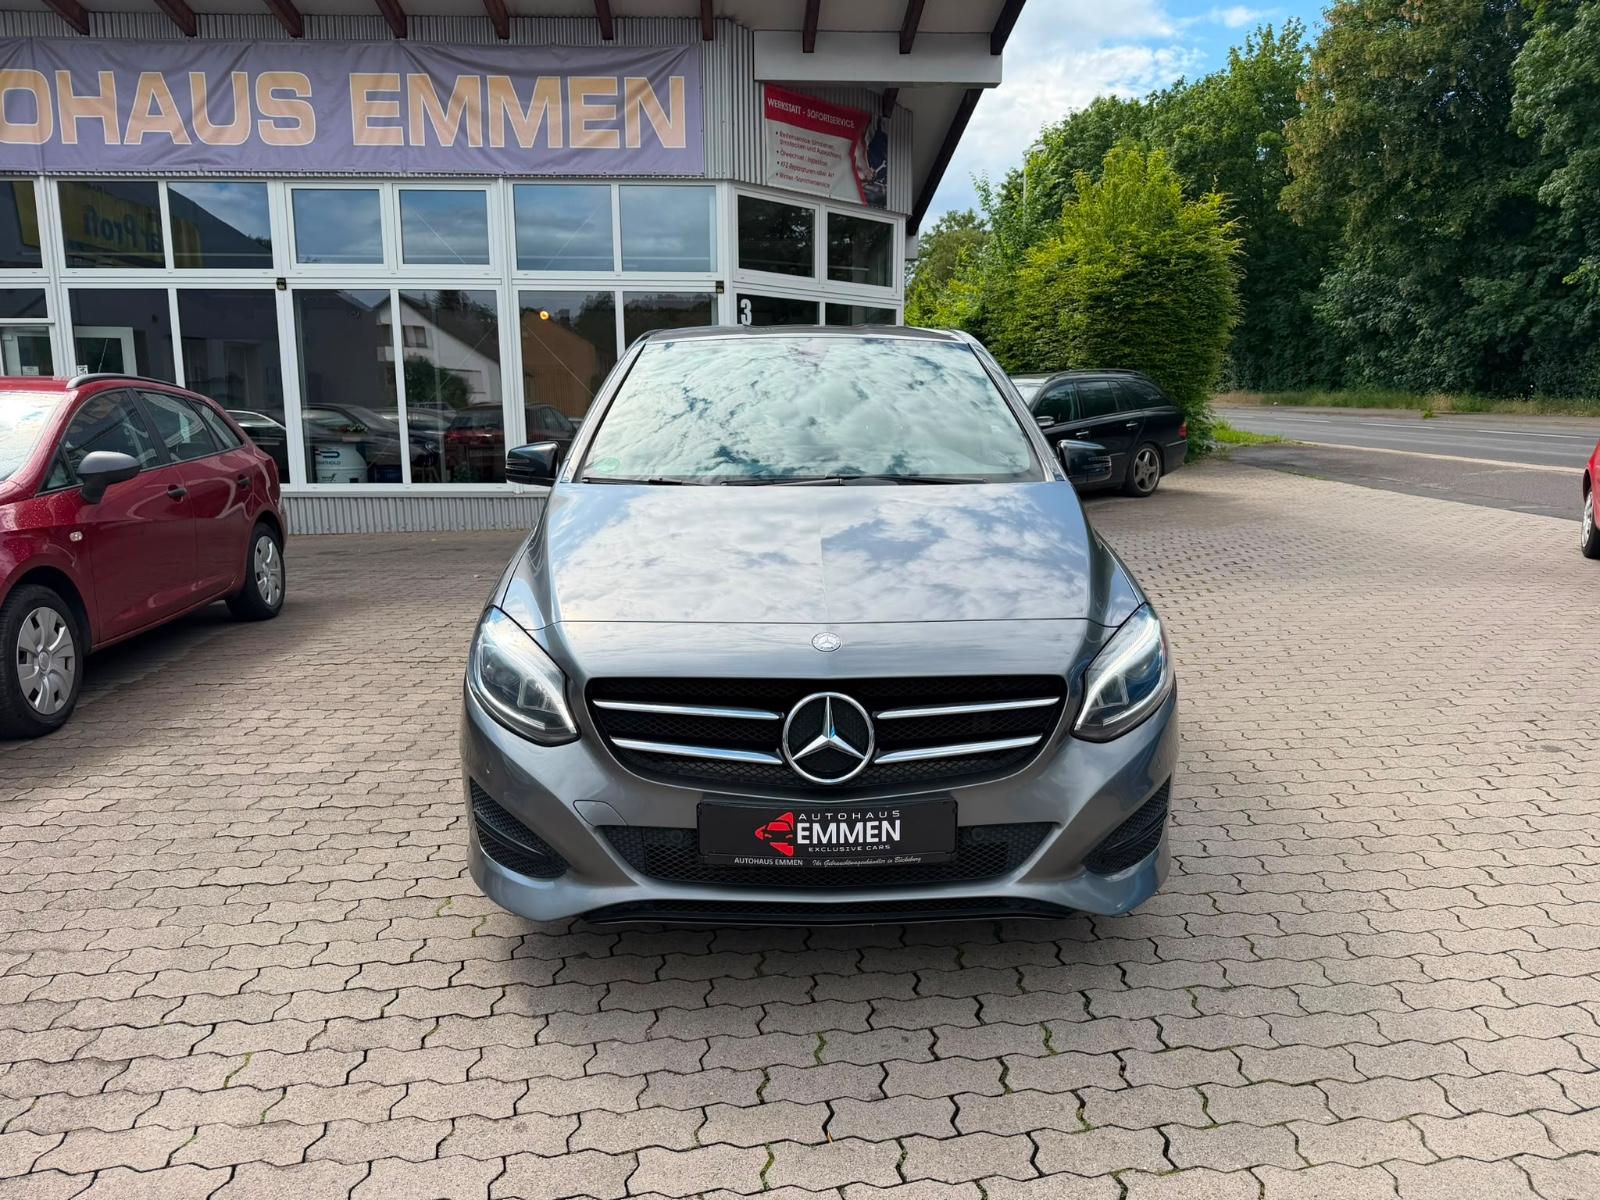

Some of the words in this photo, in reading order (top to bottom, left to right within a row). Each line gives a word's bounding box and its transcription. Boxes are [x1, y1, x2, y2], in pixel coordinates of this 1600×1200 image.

[0, 68, 316, 147] OHAUS
[349, 72, 687, 149] EMMEN
[767, 97, 801, 115] WERKSTATT
[807, 109, 855, 129] SOFORTSERVICE
[740, 298, 753, 326] 3
[798, 810, 900, 821] AUTOHAUS
[796, 819, 901, 844] EMMEN
[734, 857, 773, 865] AUTOHAUS
[775, 858, 803, 866] EMMEN
